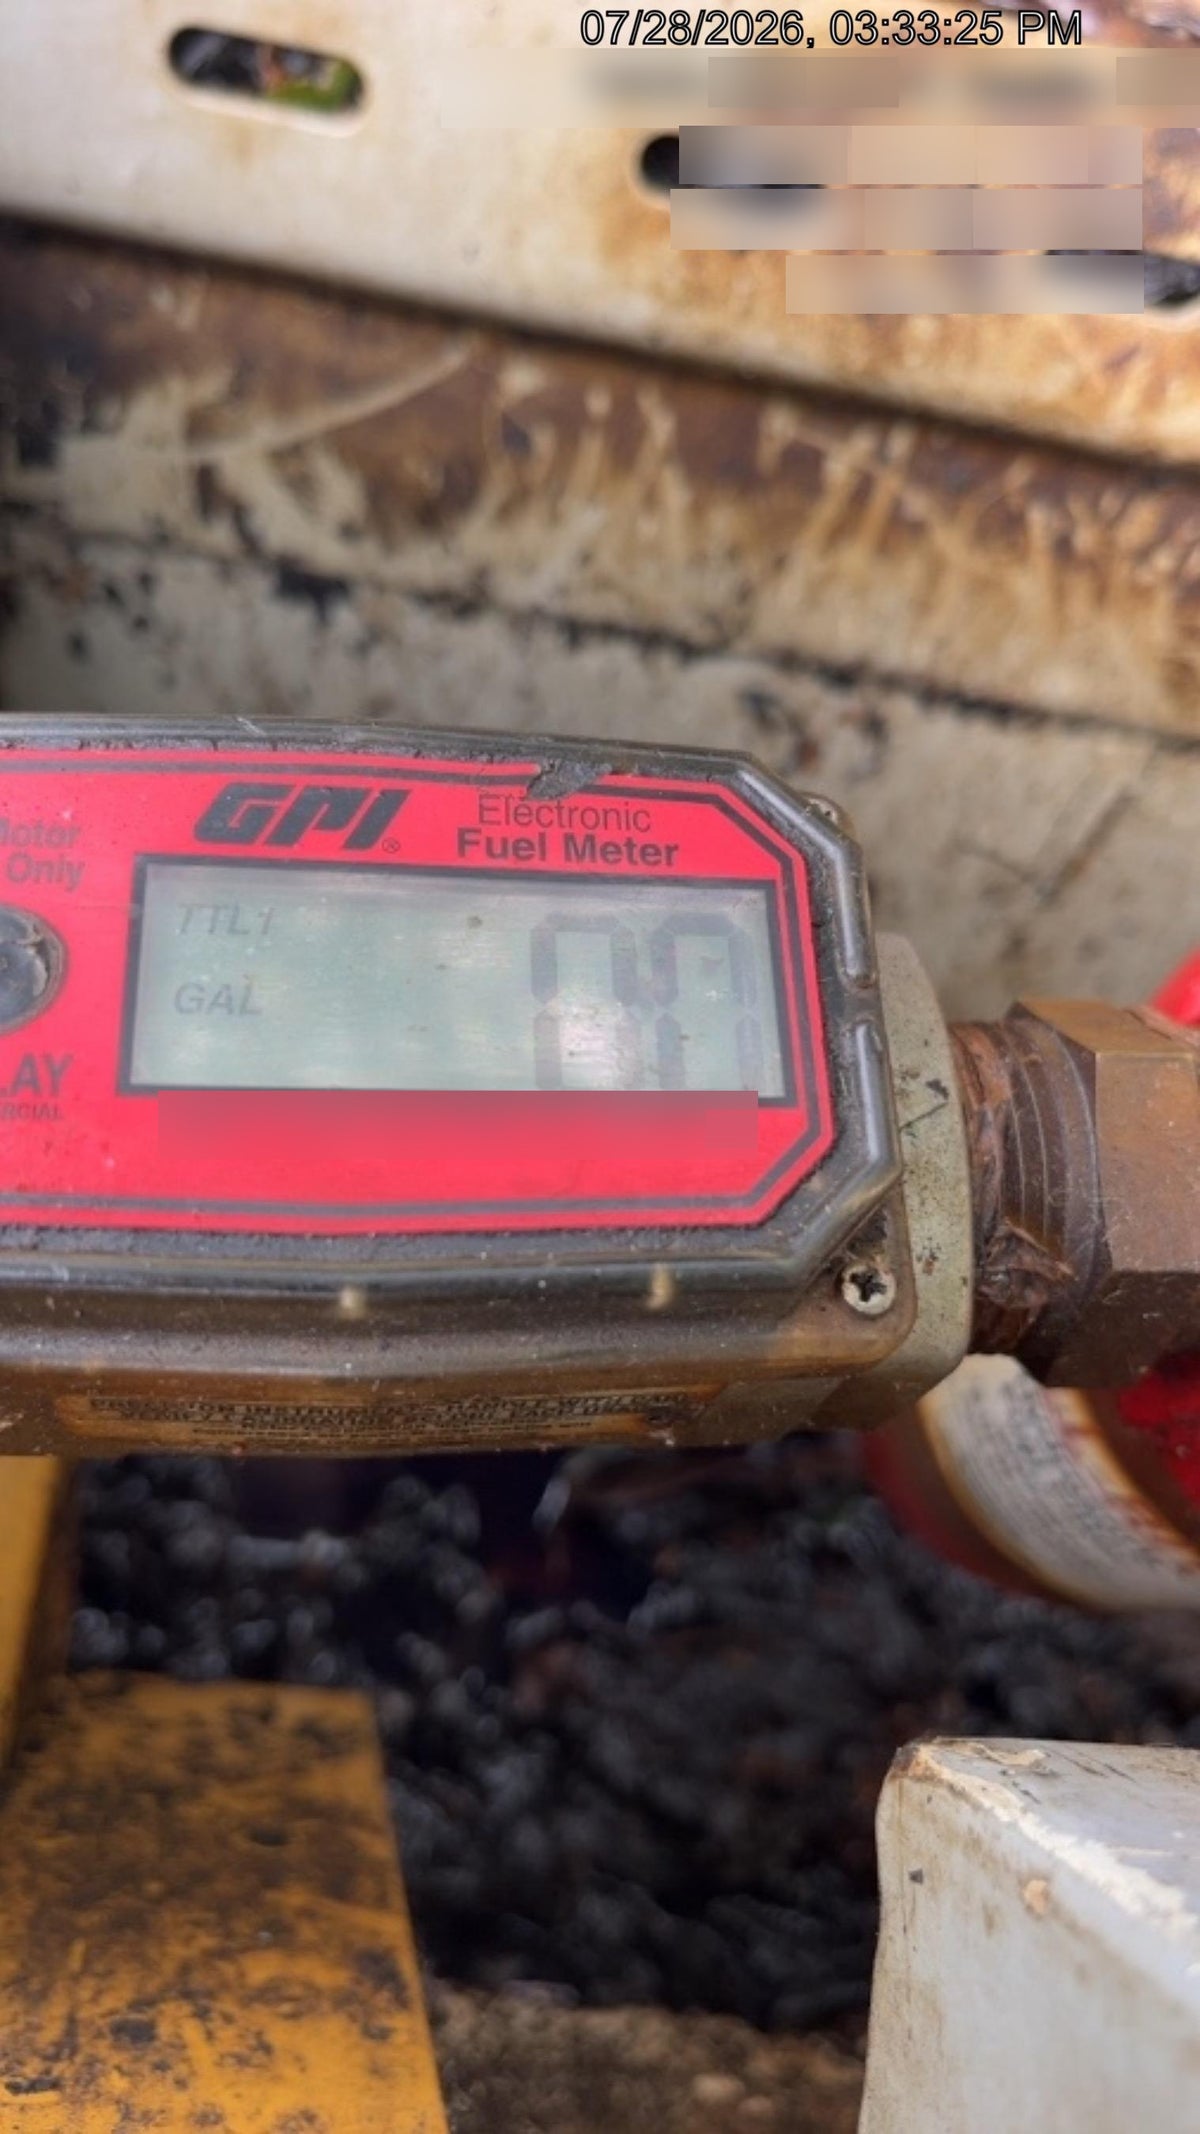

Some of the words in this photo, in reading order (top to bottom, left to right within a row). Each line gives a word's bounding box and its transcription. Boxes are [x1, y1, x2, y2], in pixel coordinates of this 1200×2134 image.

[194, 782, 411, 850] GPI
[478, 794, 652, 832] Electronic
[457, 827, 546, 863] Fuel
[563, 832, 679, 866] Meter
[6, 853, 86, 893] Only
[174, 981, 263, 1016] GAL
[0, 1051, 74, 1097] AY
